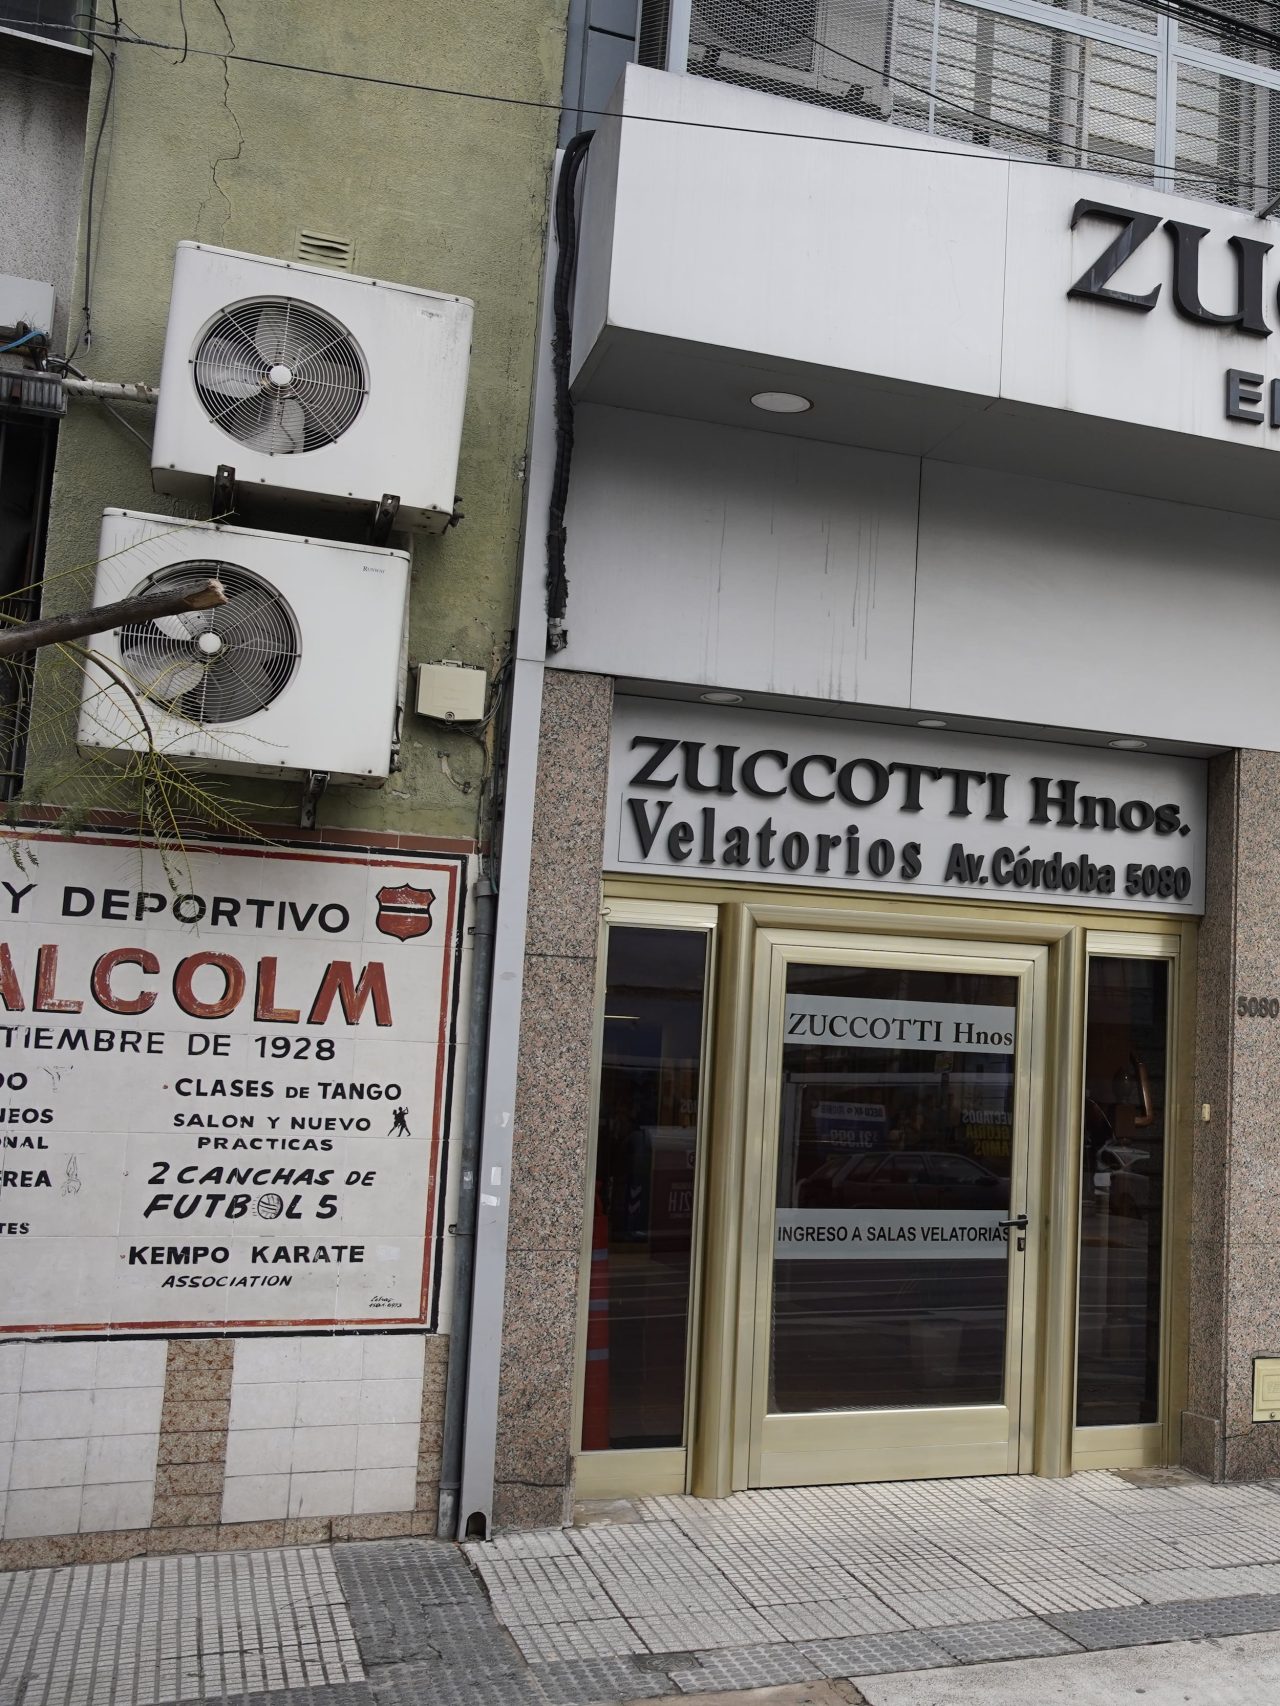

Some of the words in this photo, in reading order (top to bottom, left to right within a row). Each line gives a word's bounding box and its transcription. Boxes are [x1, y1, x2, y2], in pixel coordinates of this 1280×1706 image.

[629, 735, 1010, 819] ZUCCOTTI
[1029, 776, 1191, 836] Hnos.
[628, 797, 923, 880] Velatorios
[992, 845, 1116, 893] Córdoba
[1125, 863, 1192, 899] 5080
[1, 881, 38, 914] Y
[61, 886, 350, 934] DEPORTIVO
[1237, 996, 1279, 1018] 5080
[787, 1012, 943, 1042] ZUCCOTTI
[188, 1034, 231, 1057] DE
[255, 1036, 335, 1061] 1928
[0, 1072, 28, 1091] O
[174, 1078, 275, 1098] CLASES
[285, 1086, 310, 1099] DE
[317, 1082, 402, 1101] TANGO
[173, 1113, 255, 1129] SALON
[267, 1116, 280, 1129] Y
[290, 1116, 372, 1132] NUEVO
[0, 1136, 49, 1149] NAL
[197, 1136, 334, 1151] PRACTICAS
[0, 1170, 52, 1188] REA
[148, 1161, 170, 1185] 2
[177, 1165, 334, 1186] CANCHAS
[345, 1171, 376, 1187] DE
[315, 1194, 338, 1219] 5
[777, 1226, 848, 1242] INGRESO
[851, 1226, 863, 1242] A
[866, 1226, 917, 1242] SALAS
[920, 1226, 1009, 1242] VELATORIAS
[128, 1246, 230, 1265] KEMPO
[251, 1246, 365, 1263] KARATE
[161, 1275, 293, 1288] ASSOCIATION
